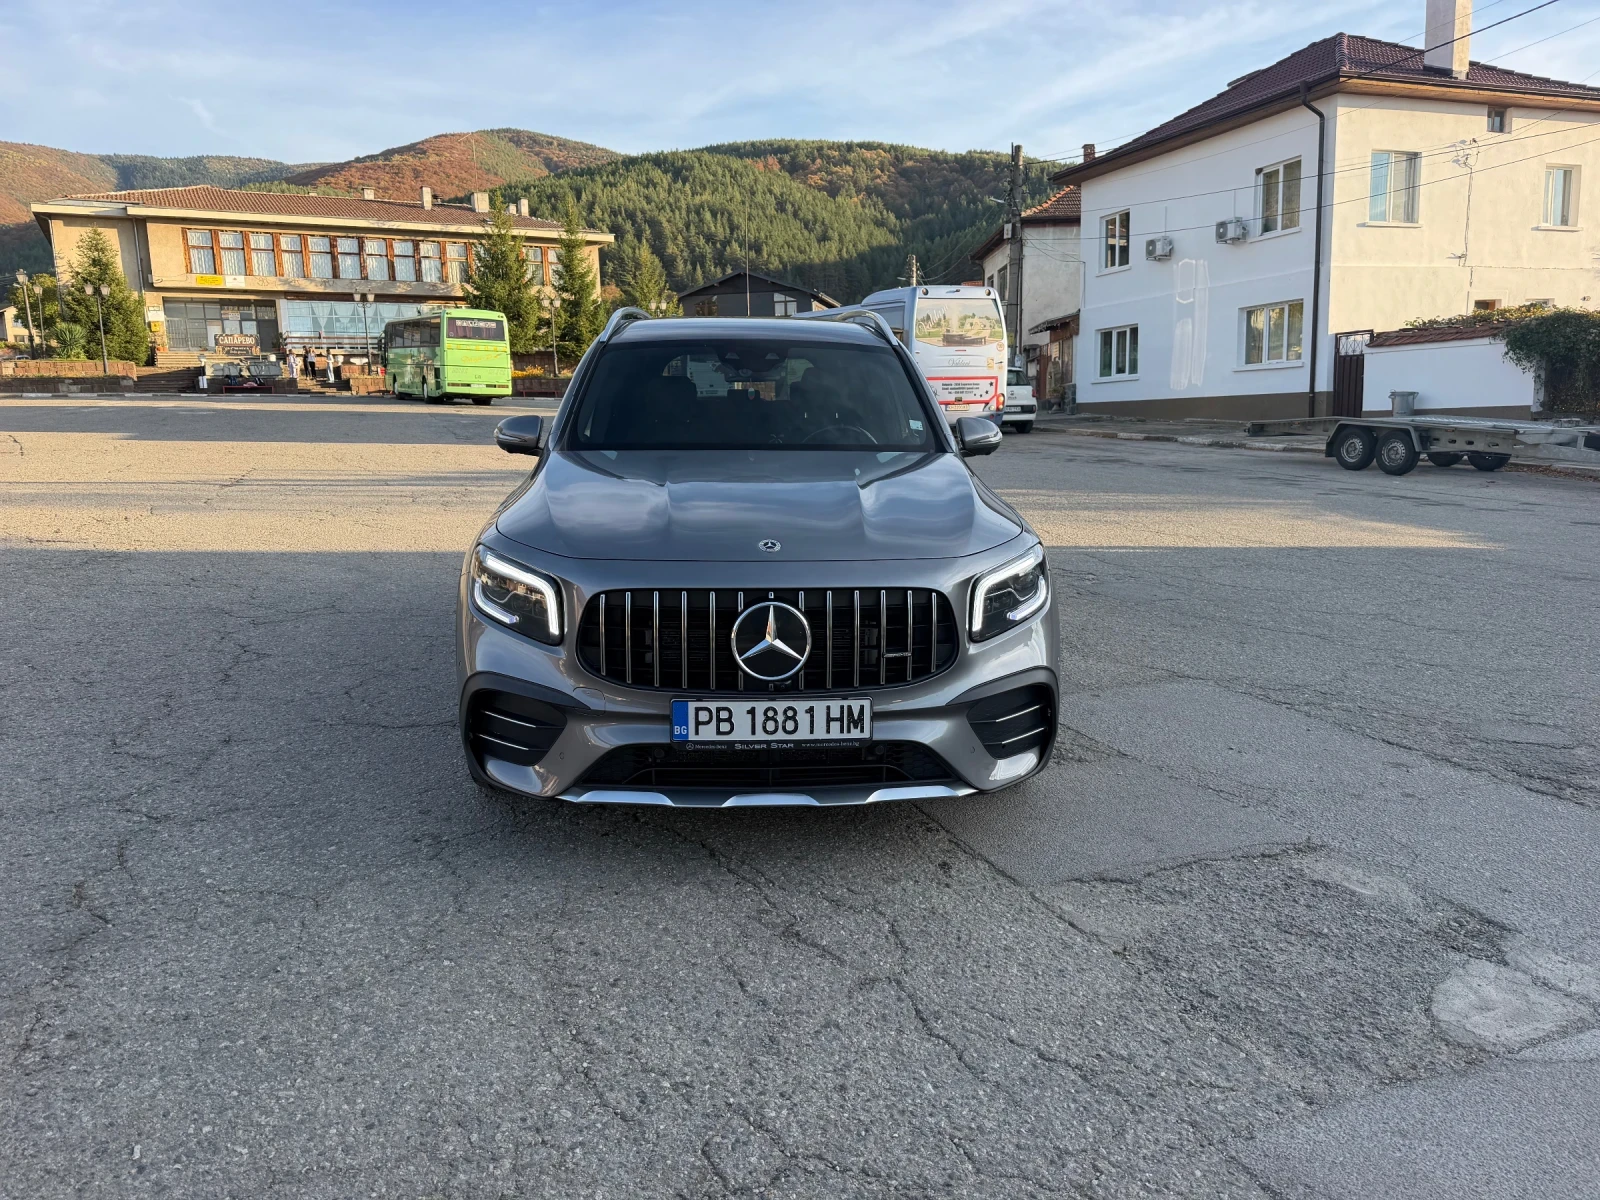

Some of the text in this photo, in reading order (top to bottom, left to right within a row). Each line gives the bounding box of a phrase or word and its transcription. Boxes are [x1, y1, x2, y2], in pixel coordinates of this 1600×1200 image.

[218, 336, 255, 345] САПАРЕВО
[694, 704, 865, 736] PB 1881 HM
[674, 725, 688, 735] BG
